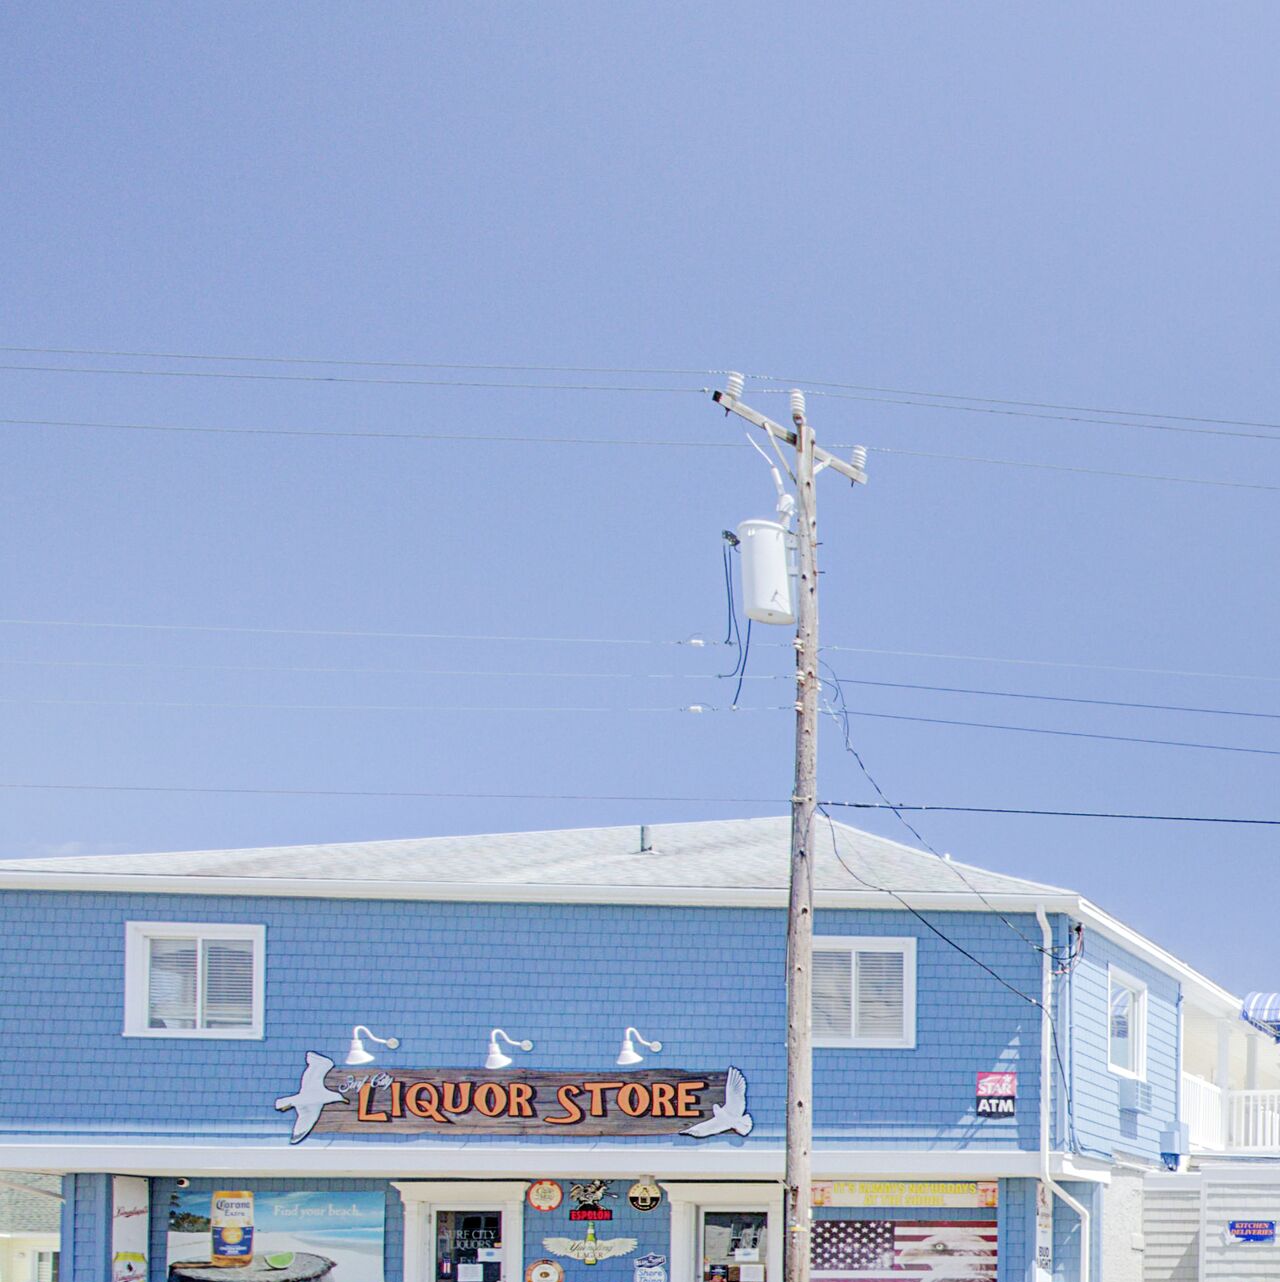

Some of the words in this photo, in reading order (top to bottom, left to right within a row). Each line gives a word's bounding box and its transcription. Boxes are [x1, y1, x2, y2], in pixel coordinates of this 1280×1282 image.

[338, 1075, 369, 1093] Surf
[370, 1072, 394, 1090] City
[978, 1079, 1011, 1095] STAR
[358, 1082, 534, 1124] LIQUOR
[543, 1082, 706, 1124] STORE
[978, 1099, 1014, 1112] ATM
[216, 1199, 251, 1211] Corona
[273, 1203, 299, 1216] Find
[300, 1207, 325, 1220] your
[472, 1230, 496, 1240] CITY
[638, 1269, 663, 1277] Shore
